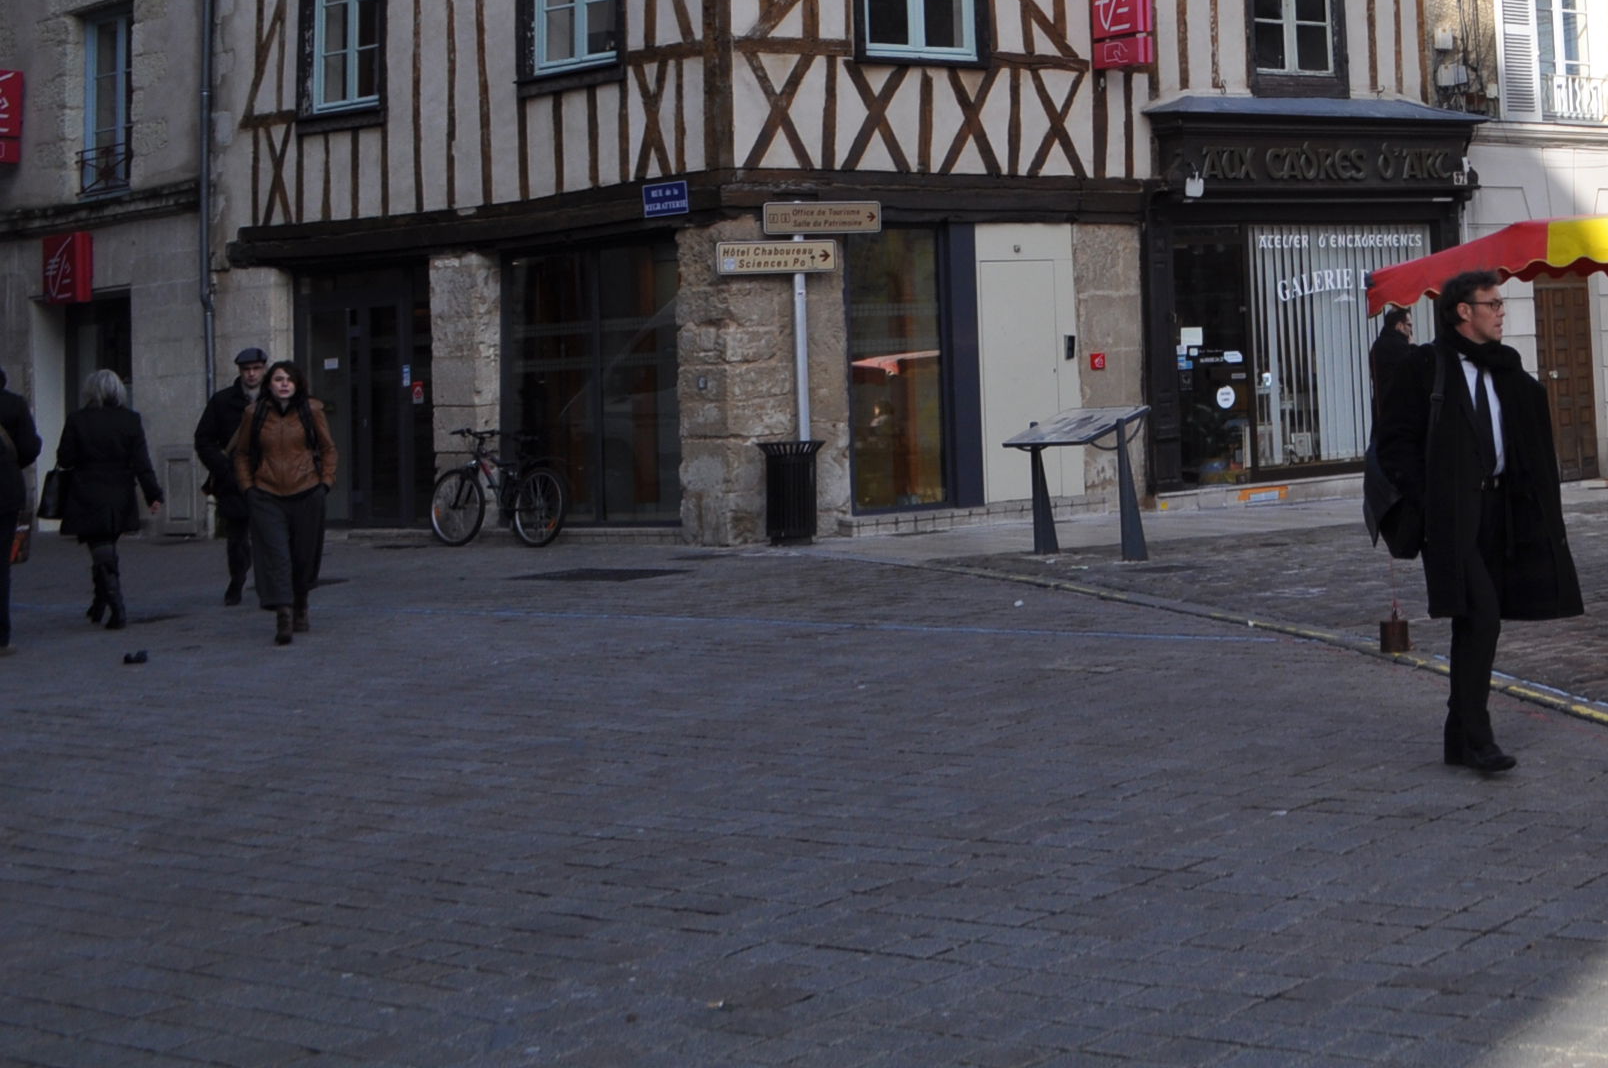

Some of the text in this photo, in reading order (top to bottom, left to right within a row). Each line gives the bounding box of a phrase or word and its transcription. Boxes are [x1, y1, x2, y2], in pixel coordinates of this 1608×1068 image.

[1202, 146, 1257, 180] AUX
[1265, 141, 1367, 180] CADRES
[792, 208, 860, 217] Office de Tourisme
[792, 220, 811, 228] Salle
[823, 219, 862, 227] Patrimoine
[1258, 234, 1309, 249] ATELIER
[722, 246, 814, 257] Hôtel Chaboureau
[738, 257, 806, 269] Sciences Po
[1276, 268, 1353, 302] GALERIE
